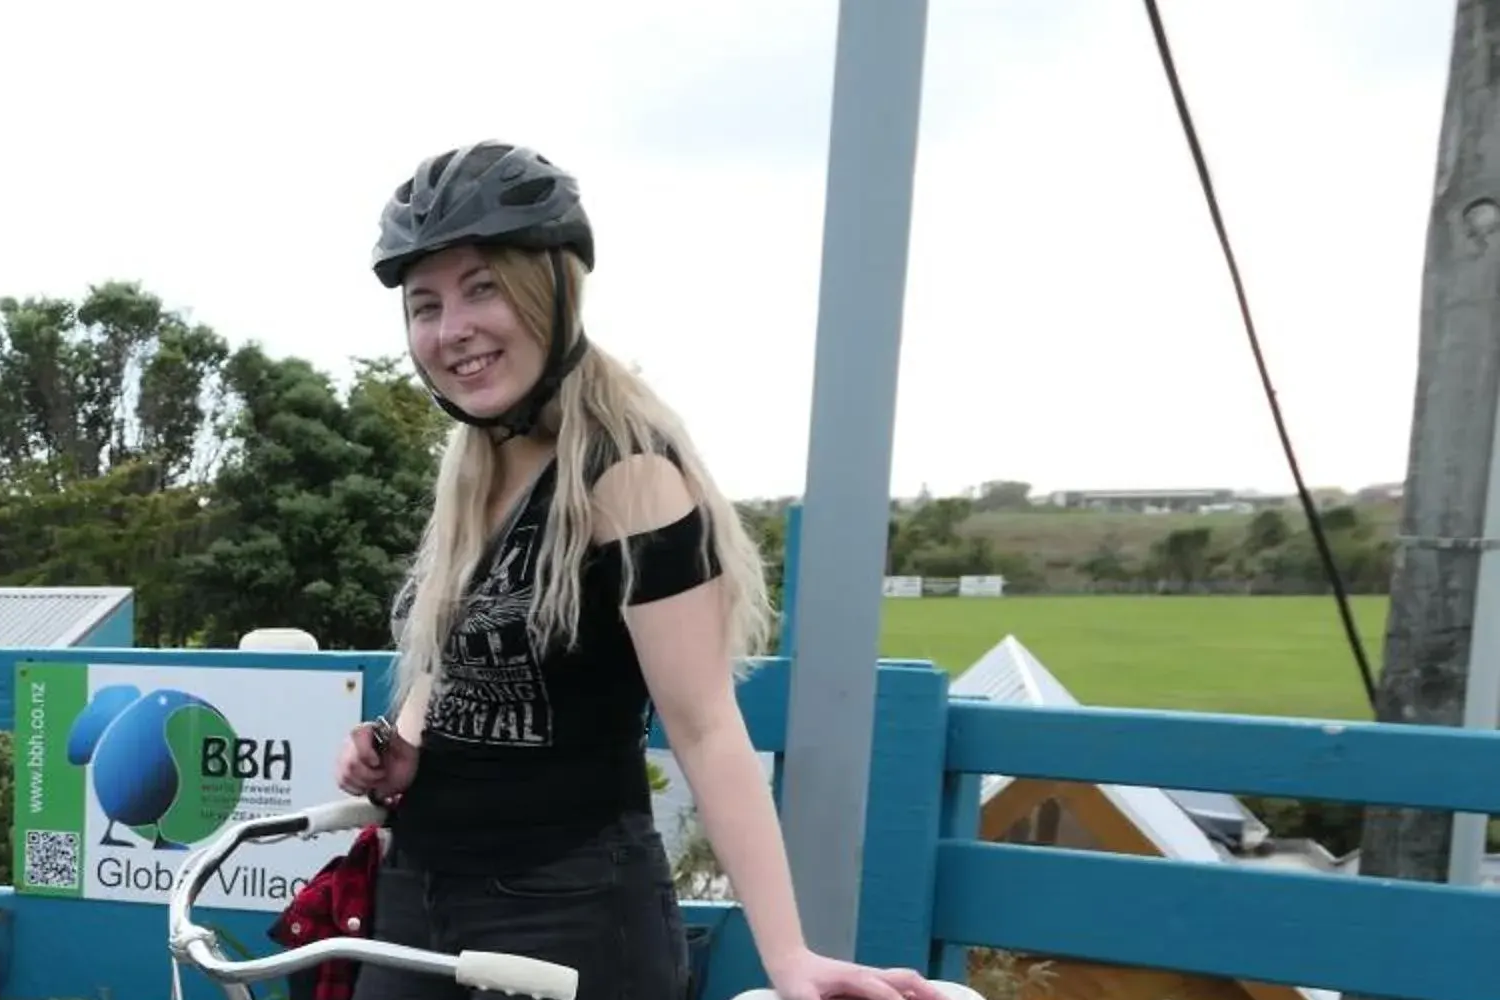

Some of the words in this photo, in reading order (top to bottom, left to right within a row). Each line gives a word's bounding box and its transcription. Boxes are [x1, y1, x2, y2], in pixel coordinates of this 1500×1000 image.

[27, 681, 46, 813] www.bbh.co.nz
[201, 736, 292, 781] BBH
[97, 857, 189, 891] Glob
[217, 865, 309, 899] Villa
